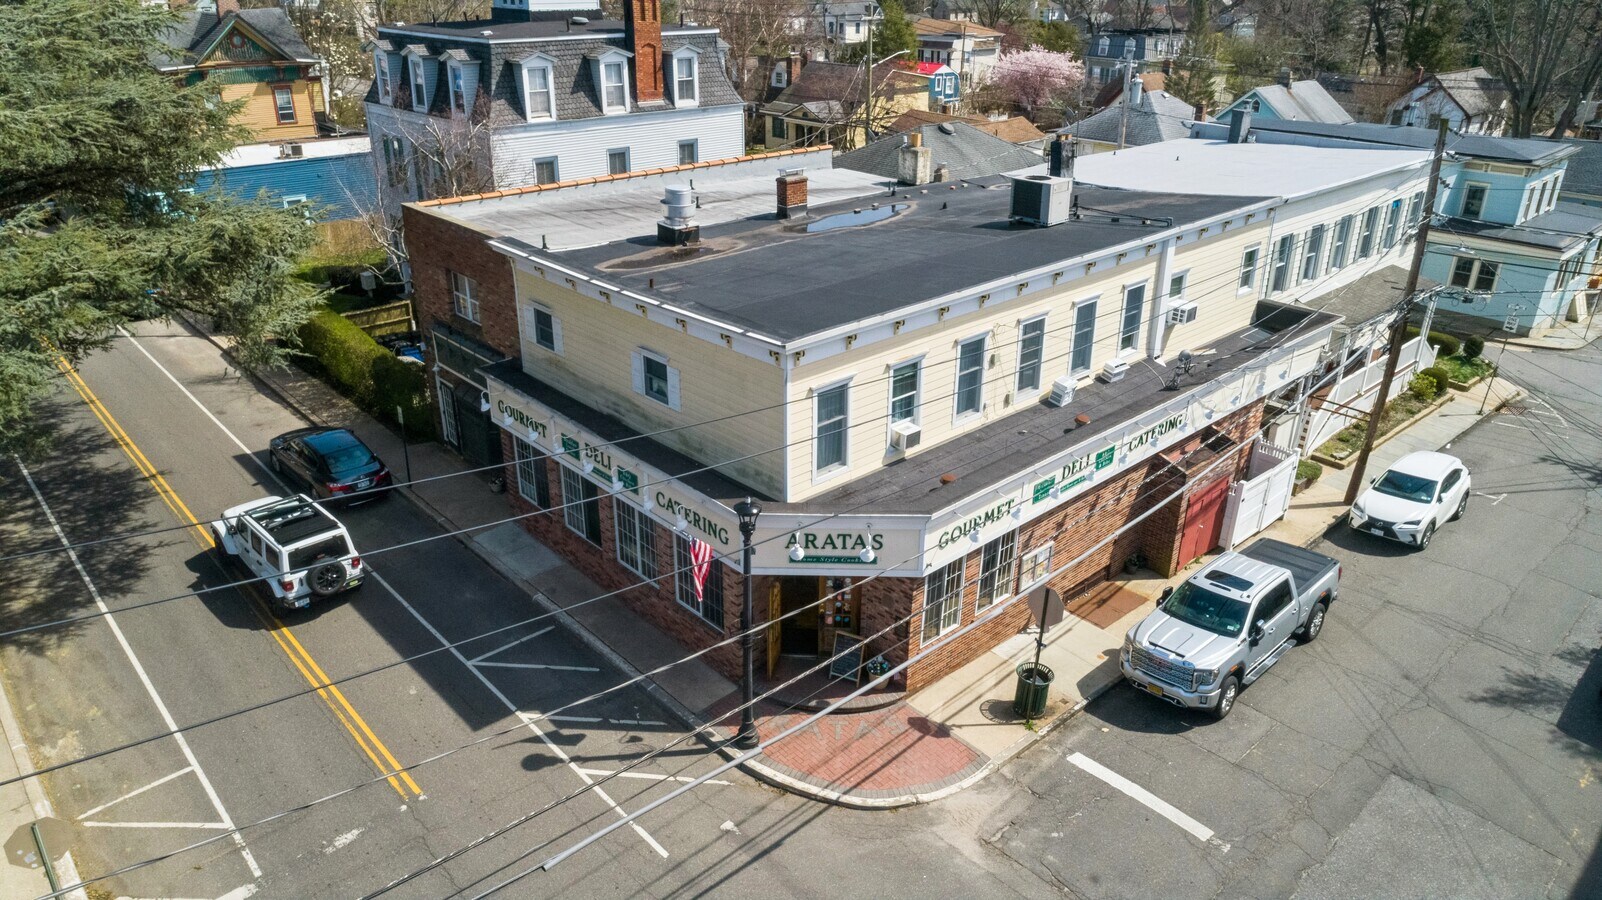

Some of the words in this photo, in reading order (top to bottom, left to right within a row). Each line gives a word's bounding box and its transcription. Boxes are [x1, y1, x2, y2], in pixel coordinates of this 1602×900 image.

[497, 399, 547, 438] GOURMET
[584, 442, 611, 471] DELI
[655, 491, 729, 545] CATERING
[938, 498, 1016, 550] GOURMET
[1061, 452, 1091, 482] DELI
[1128, 413, 1183, 452] CATERING
